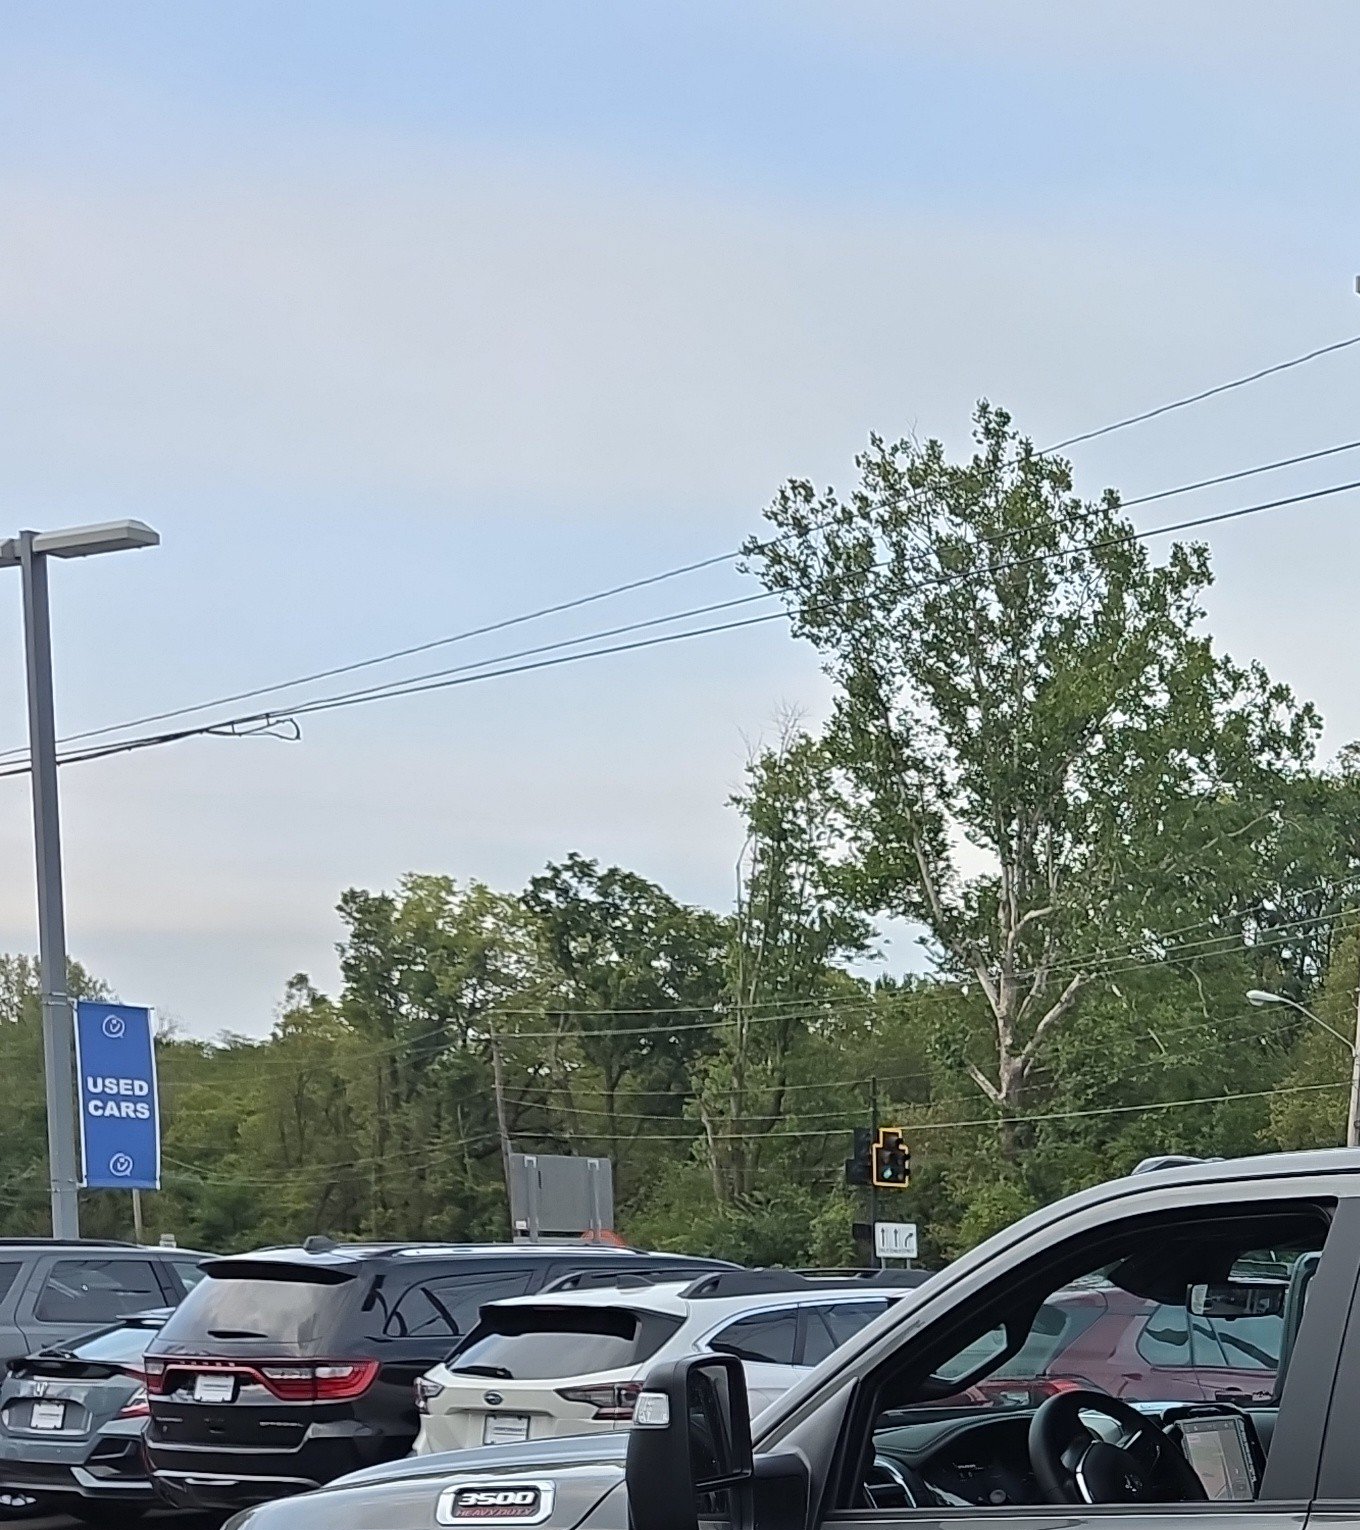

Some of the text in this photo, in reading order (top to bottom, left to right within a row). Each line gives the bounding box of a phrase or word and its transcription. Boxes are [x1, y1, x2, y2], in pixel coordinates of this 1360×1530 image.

[86, 1076, 149, 1096] USED
[88, 1100, 150, 1119] CARS
[458, 1491, 536, 1506] 3500
